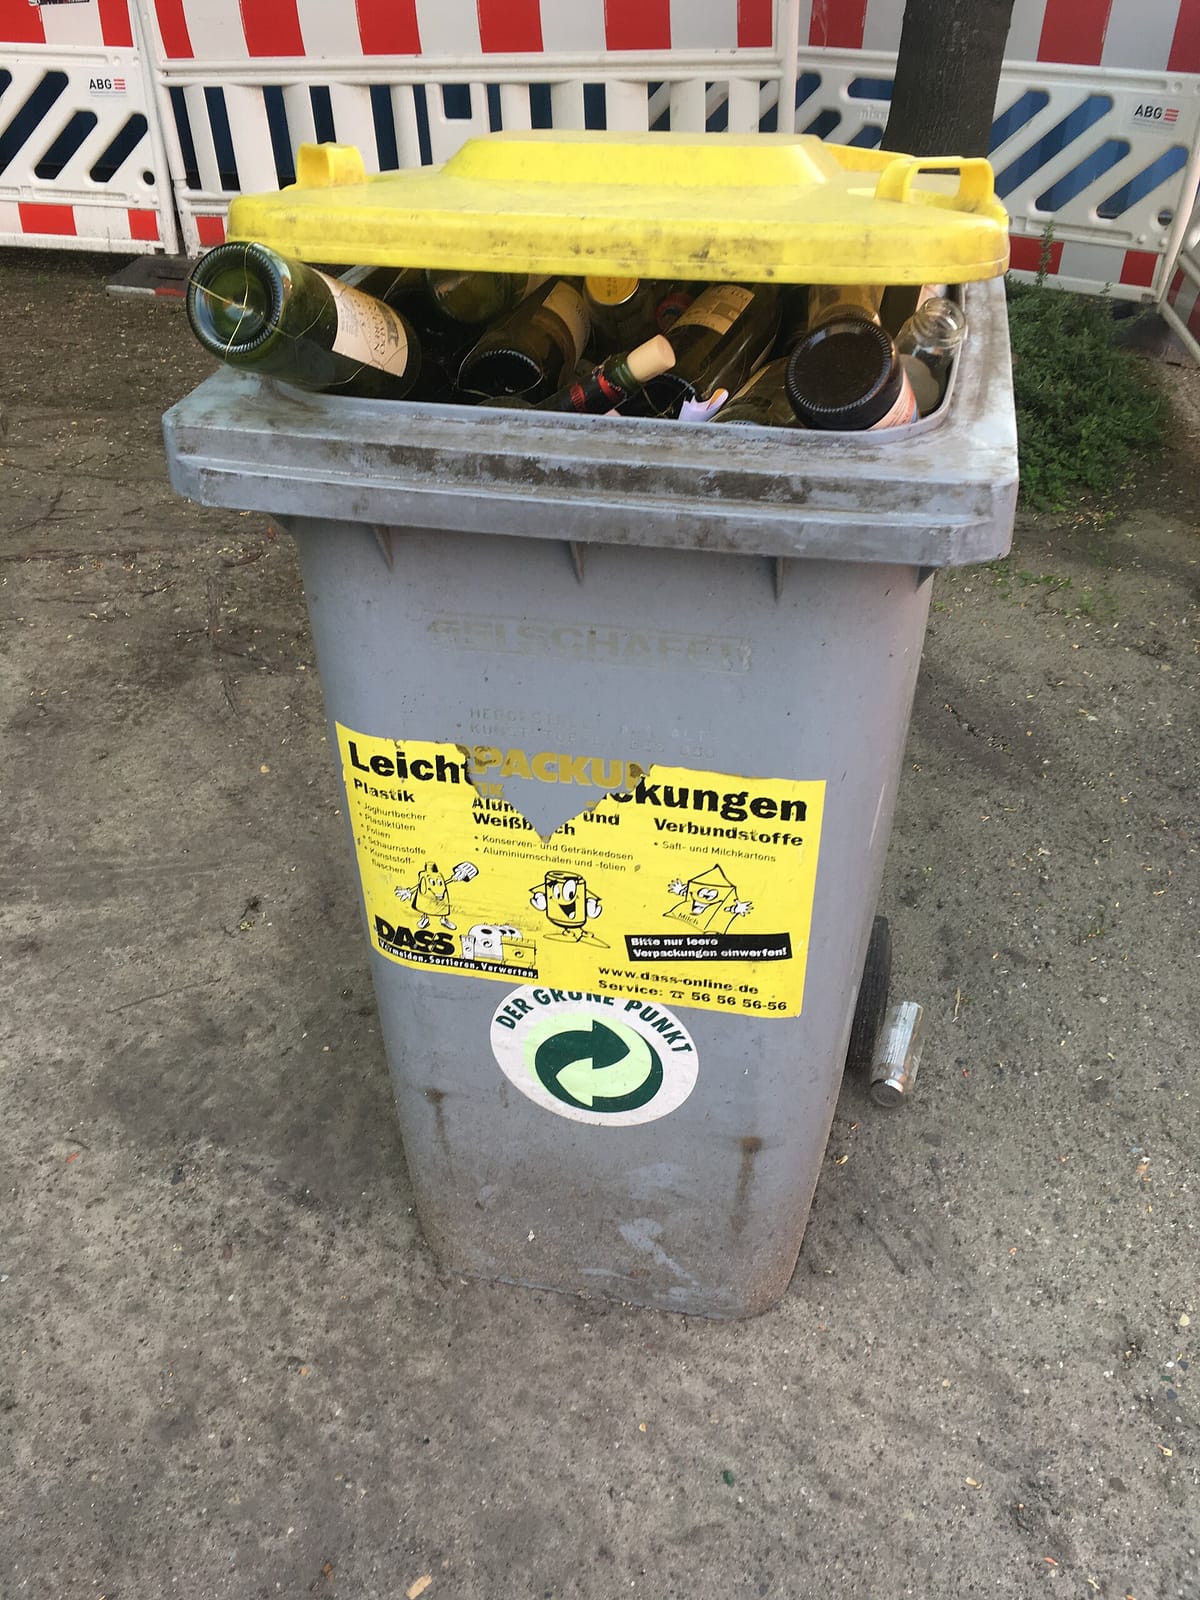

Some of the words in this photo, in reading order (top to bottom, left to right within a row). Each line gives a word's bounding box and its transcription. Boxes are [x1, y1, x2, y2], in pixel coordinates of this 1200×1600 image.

[89, 78, 112, 90] ABG
[1134, 104, 1163, 120] ABG
[353, 777, 415, 803] Plastik
[364, 802, 427, 821] Joghurtbecher
[583, 811, 620, 826] und
[365, 813, 416, 832] Plastiktüten
[654, 817, 804, 847] Verbundstoffe
[366, 825, 391, 840] Folien
[367, 836, 427, 855] Schaumstoffe
[482, 834, 538, 850] Konserven-
[539, 842, 559, 852] und
[560, 843, 635, 862] Getränkedosen
[662, 840, 687, 851] Saft-
[689, 845, 709, 854] und
[711, 846, 777, 863] Milchkartons
[369, 847, 416, 865] Kunststoff-
[483, 846, 573, 866] Aluminiumschalen
[574, 858, 593, 868] und
[371, 858, 406, 875] flaschen
[678, 912, 699, 926] Milch
[375, 914, 456, 955] DASS
[630, 937, 661, 947] Bitte
[663, 938, 684, 947] nur
[687, 938, 719, 947] leere
[632, 948, 719, 960] Verpackungen
[721, 947, 788, 959] einwerfen!
[598, 966, 759, 995] www.dass-online.de
[598, 979, 664, 997] Service:
[690, 991, 711, 1003] 56
[716, 995, 737, 1007] 56
[742, 998, 788, 1012] 56-56
[495, 998, 534, 1031] DER
[623, 999, 693, 1054] PUNKT
